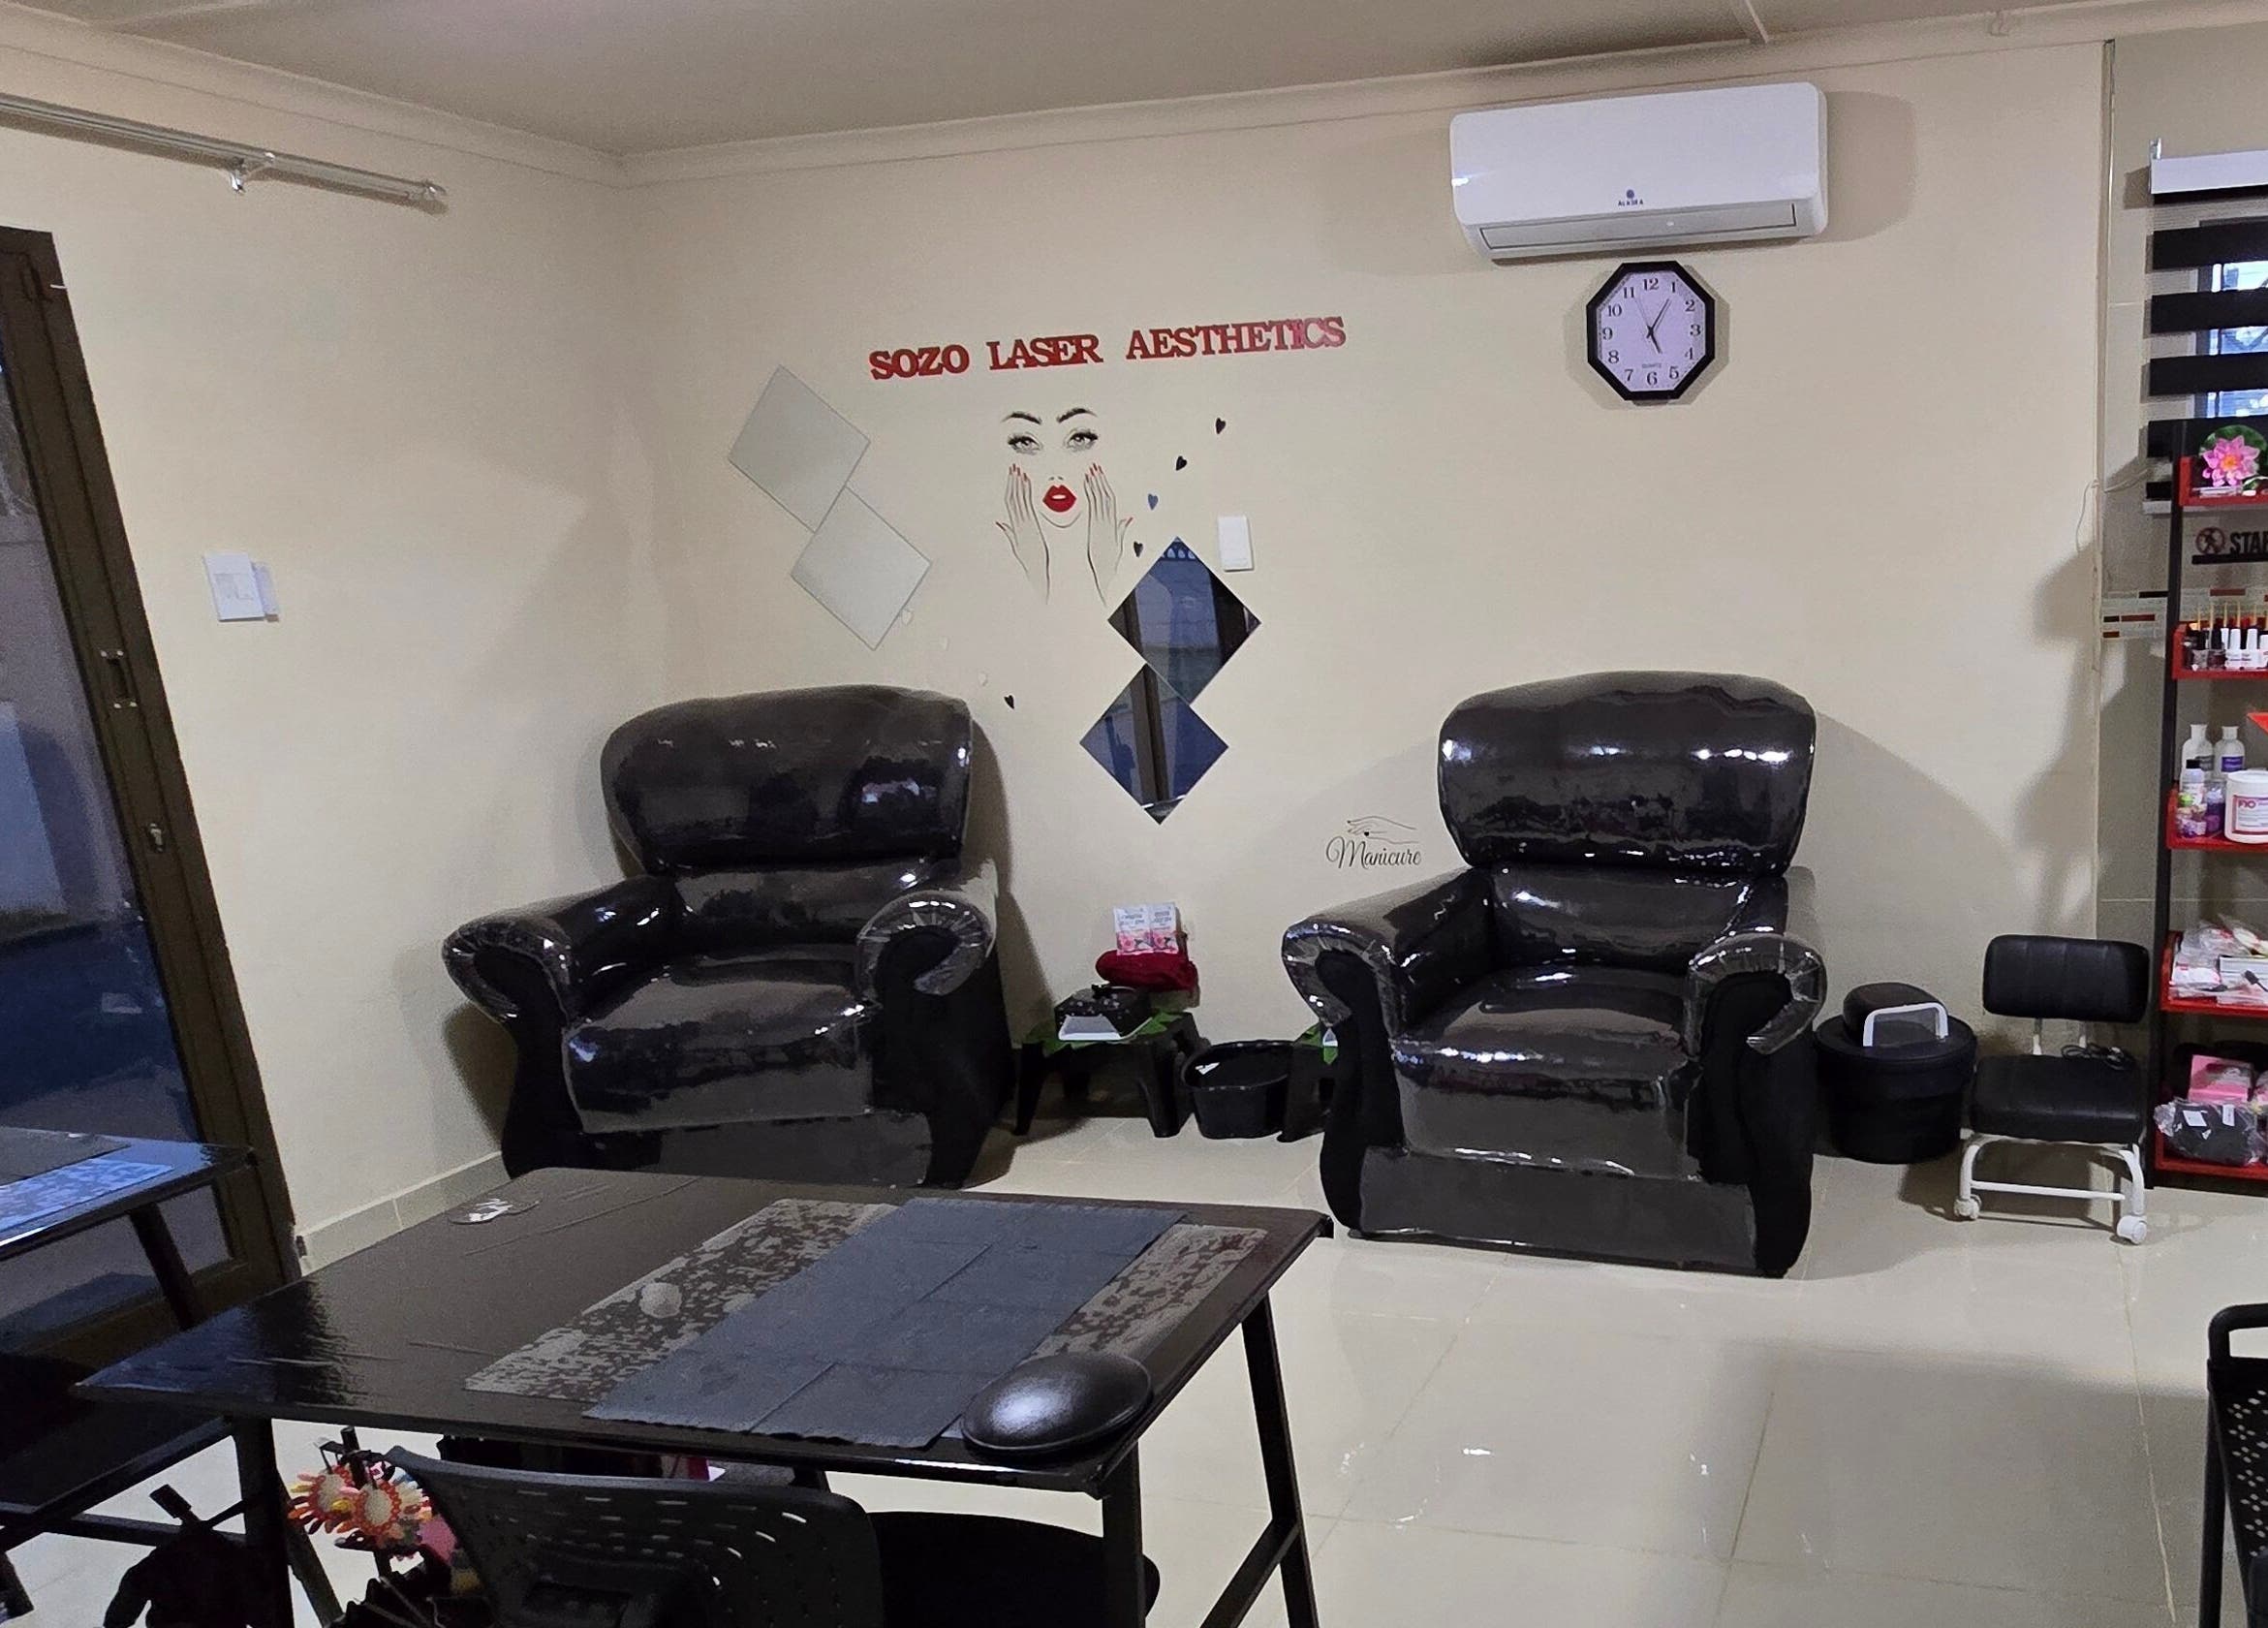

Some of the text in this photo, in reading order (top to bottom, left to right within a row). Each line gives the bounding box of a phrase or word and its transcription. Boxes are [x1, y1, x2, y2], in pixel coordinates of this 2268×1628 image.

[1643, 278, 1660, 291] 12
[1624, 287, 1635, 298] 11
[1608, 303, 1623, 317] 10
[1685, 299, 1695, 312] 2
[1602, 328, 1613, 340] 9
[1690, 324, 1701, 336] 3
[869, 316, 1347, 380] SOZO LASER AESTHETICS
[1685, 347, 1693, 360] 4
[1608, 350, 1620, 364] 8
[1624, 369, 1633, 382] 7
[1647, 371, 1658, 386] 6
[1669, 366, 1679, 379] 5
[1325, 835, 1422, 870] Manicure
